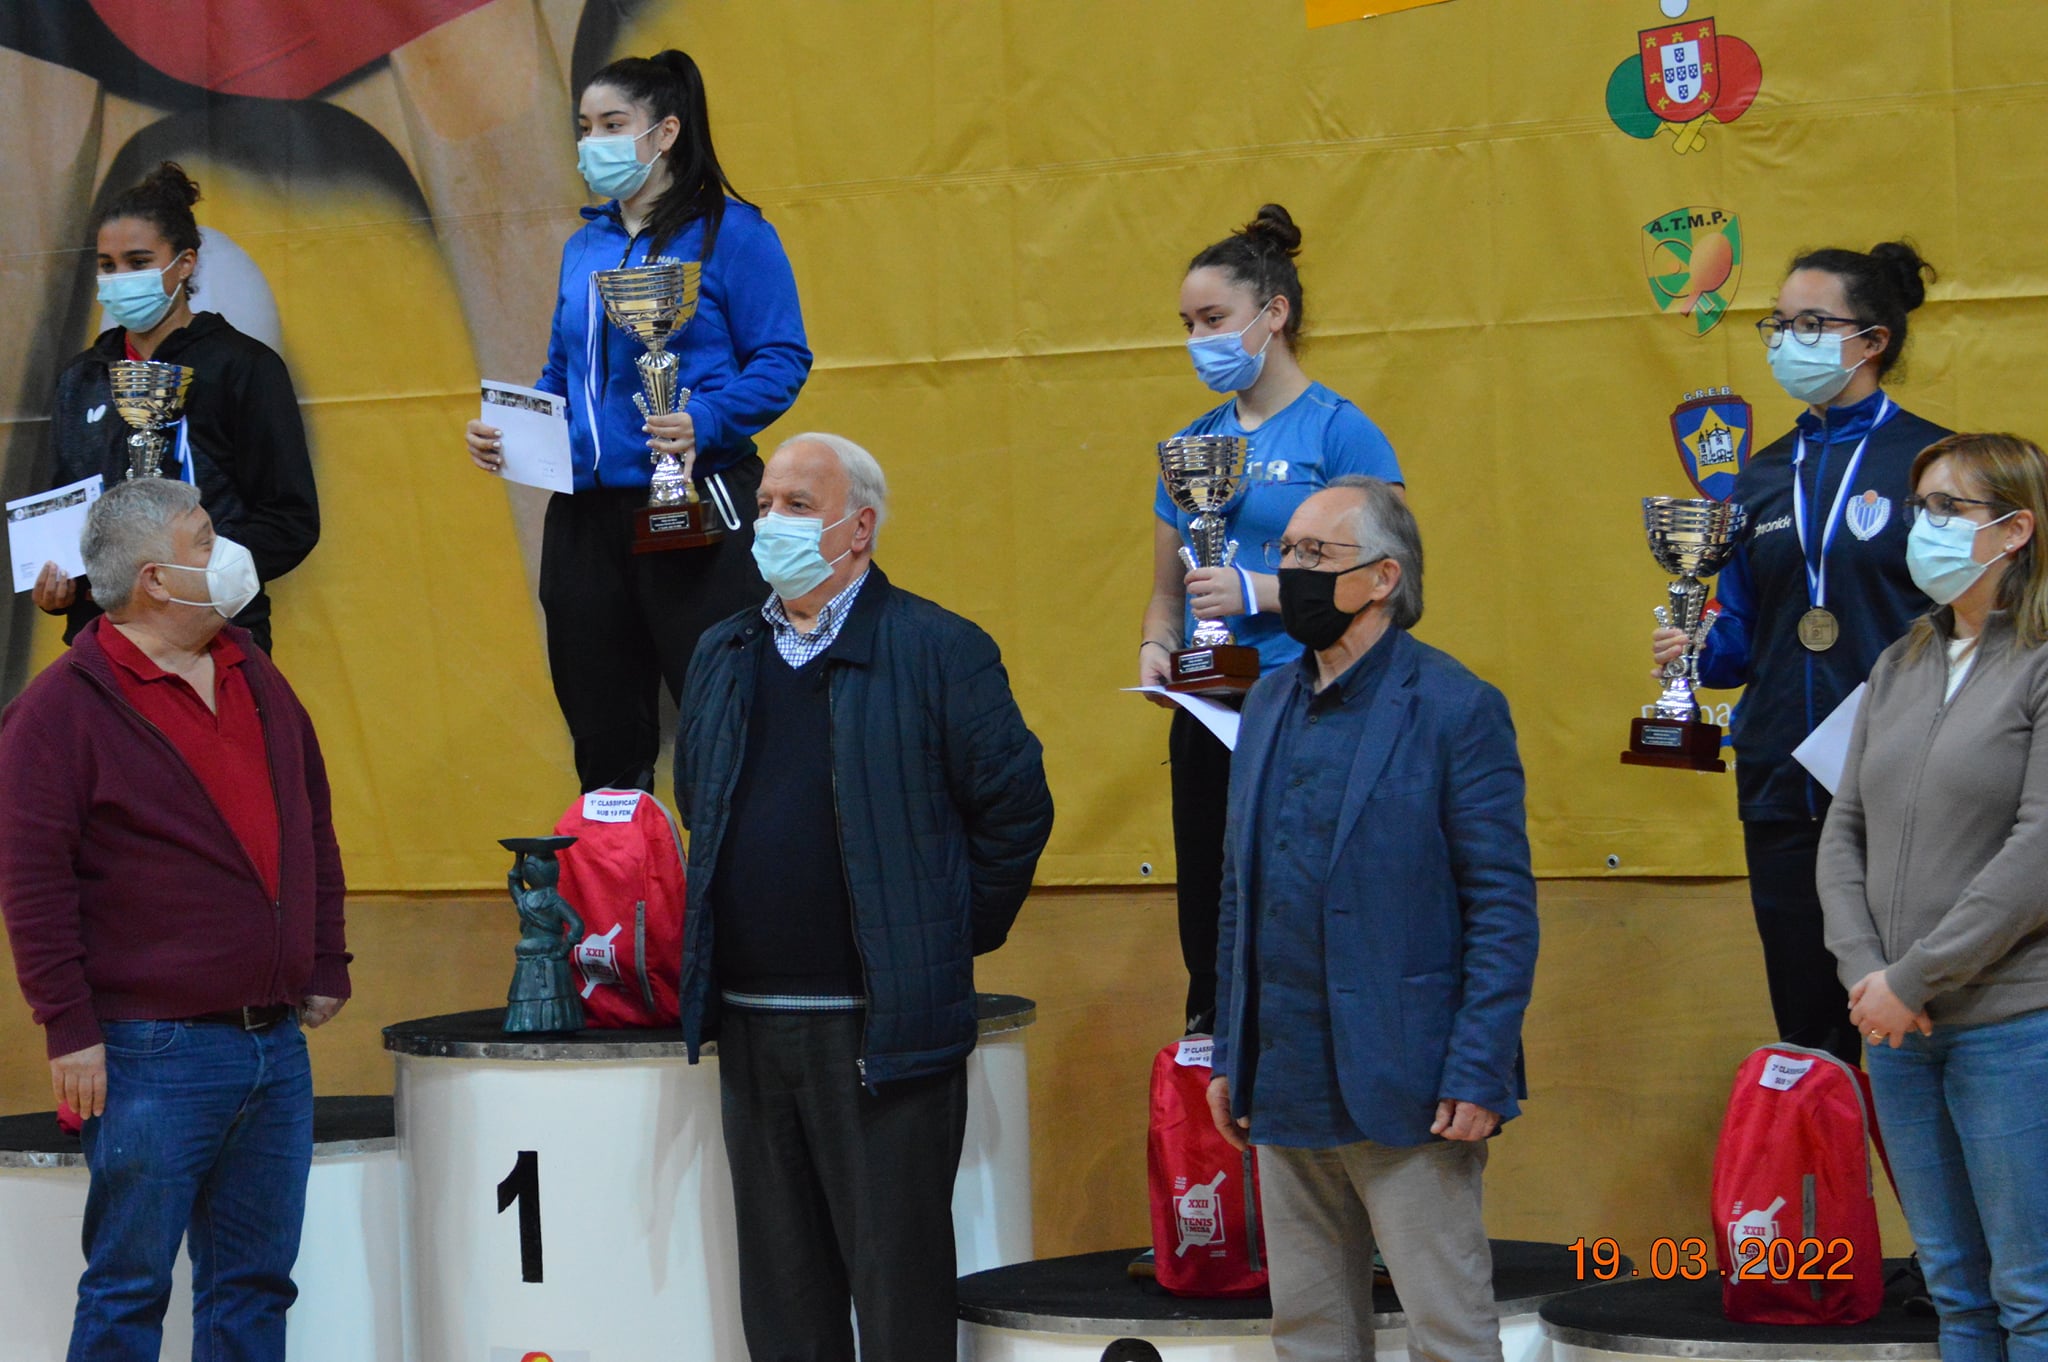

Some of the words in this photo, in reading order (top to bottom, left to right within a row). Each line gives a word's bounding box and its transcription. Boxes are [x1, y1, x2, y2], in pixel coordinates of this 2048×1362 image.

[1649, 211, 1728, 235] A.T.M.P.
[1187, 1199, 1209, 1209] XXII
[497, 1150, 543, 1283] 1
[1743, 1225, 1766, 1236] XXII
